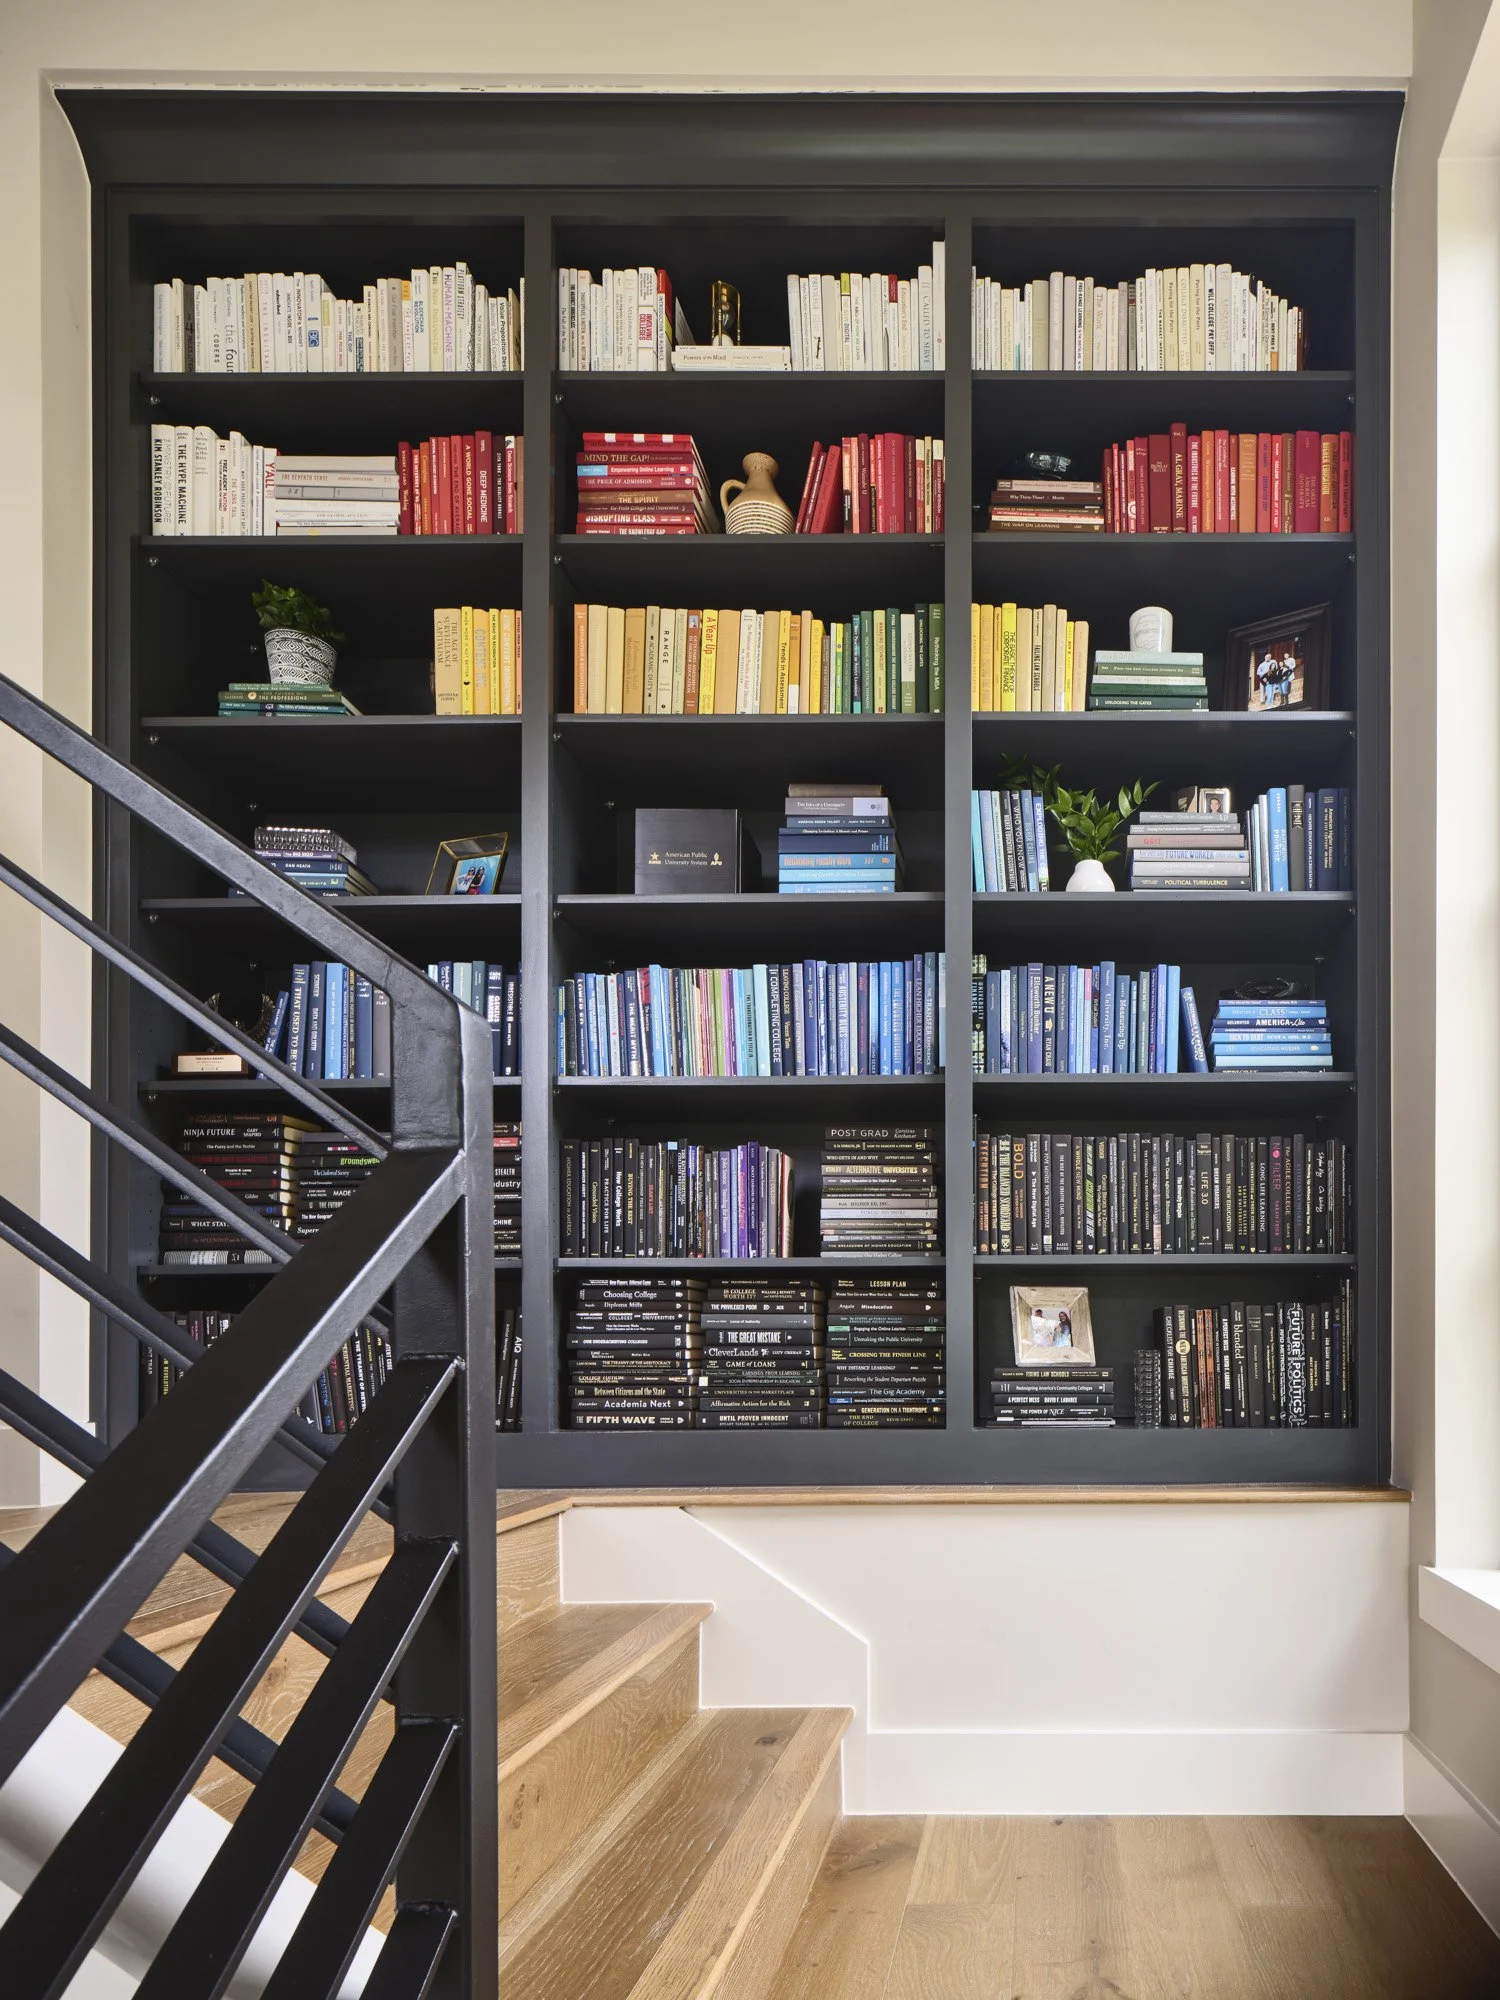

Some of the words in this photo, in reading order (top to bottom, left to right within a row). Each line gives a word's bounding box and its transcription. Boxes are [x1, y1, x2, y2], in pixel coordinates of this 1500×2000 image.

[224, 325, 236, 344] the
[924, 328, 930, 339] TO
[226, 349, 237, 372] four
[178, 444, 186, 460] THE
[630, 454, 650, 462] GAP!
[1176, 454, 1182, 464] AL
[178, 463, 186, 484] HYPE
[266, 462, 275, 488] Y'ALL
[1174, 465, 1182, 486] GRAY,
[178, 486, 186, 524] MACHINE
[706, 625, 716, 642] Year
[704, 644, 715, 654] Up
[452, 654, 458, 663] OF
[1036, 803, 1044, 846] EXPLODING
[1040, 863, 1048, 892] CTLE
[294, 988, 302, 1010] THAT
[771, 976, 780, 1026] COMPLETING
[839, 986, 847, 1017] AUSTERITY
[1045, 984, 1054, 1004] NEW
[1258, 1008, 1286, 1016] CLASS
[292, 1012, 300, 1034] USED
[840, 1020, 848, 1038] BLUES
[292, 1036, 298, 1048] TO
[773, 1028, 781, 1063] COLLEGE
[1118, 1038, 1126, 1050] Up
[290, 1049, 298, 1060] BE
[184, 1128, 205, 1138] NINJA
[831, 1130, 857, 1138] POST
[860, 1130, 889, 1138] GRAD
[1000, 1153, 1010, 1166] THE
[1014, 1143, 1024, 1179] BOLD
[1000, 1167, 1010, 1196] BALANCED
[1000, 1197, 1010, 1231] SCORECARD
[604, 1290, 633, 1298] Choosing
[634, 1290, 658, 1298] College
[728, 1332, 740, 1343] THE
[740, 1332, 756, 1343] GREAT
[757, 1332, 782, 1343] MISTAKE
[1234, 1324, 1244, 1359] blended
[1292, 1310, 1300, 1356] FUTURE
[514, 1336, 522, 1353] AIQ
[708, 1348, 759, 1356] CleverLands
[883, 1388, 895, 1396] Gig
[896, 1388, 926, 1396] Academy
[1292, 1362, 1302, 1414] POLITICS
